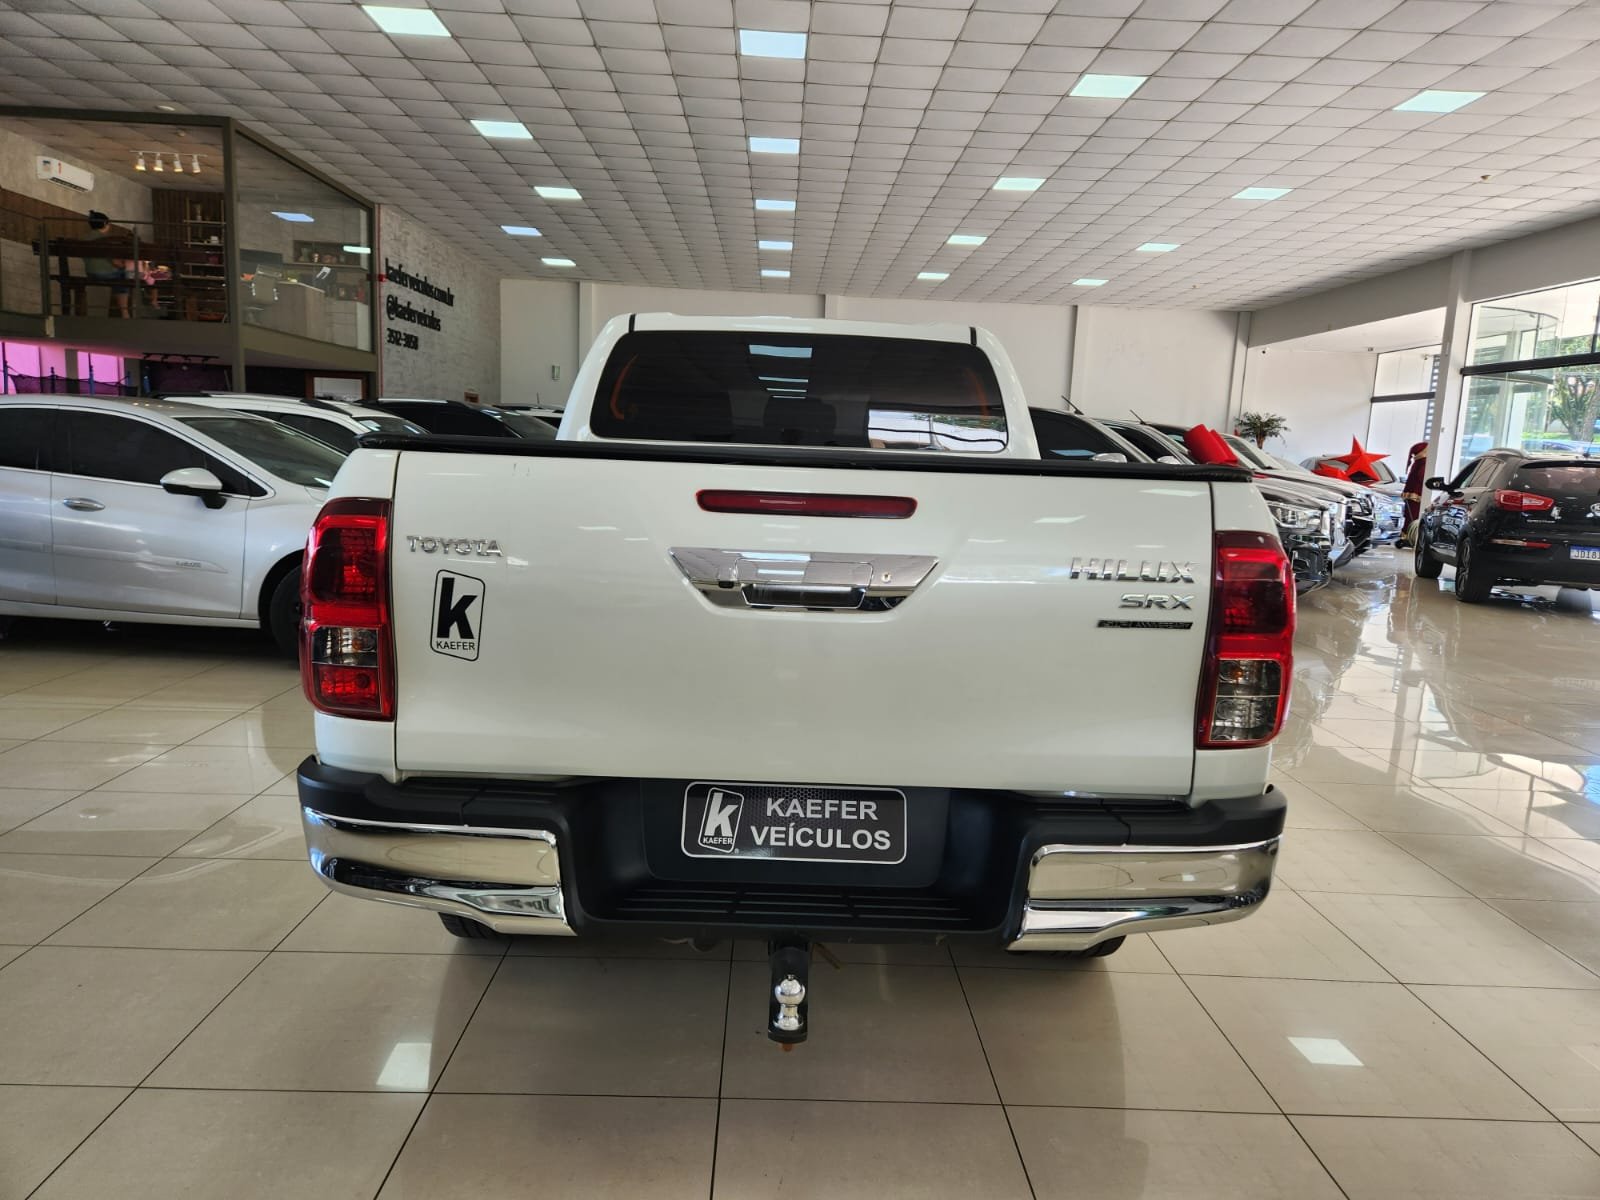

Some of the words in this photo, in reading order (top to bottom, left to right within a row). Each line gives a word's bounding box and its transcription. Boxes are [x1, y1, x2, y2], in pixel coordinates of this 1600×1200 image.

[406, 535, 503, 557] TOYOTA
[1070, 557, 1197, 583] HILUX
[1119, 593, 1195, 610] SRX
[436, 641, 475, 651] KAEFER
[766, 798, 878, 820] KAEFER
[702, 837, 734, 846] KAEFER
[750, 823, 891, 850] VEÍCULOS
